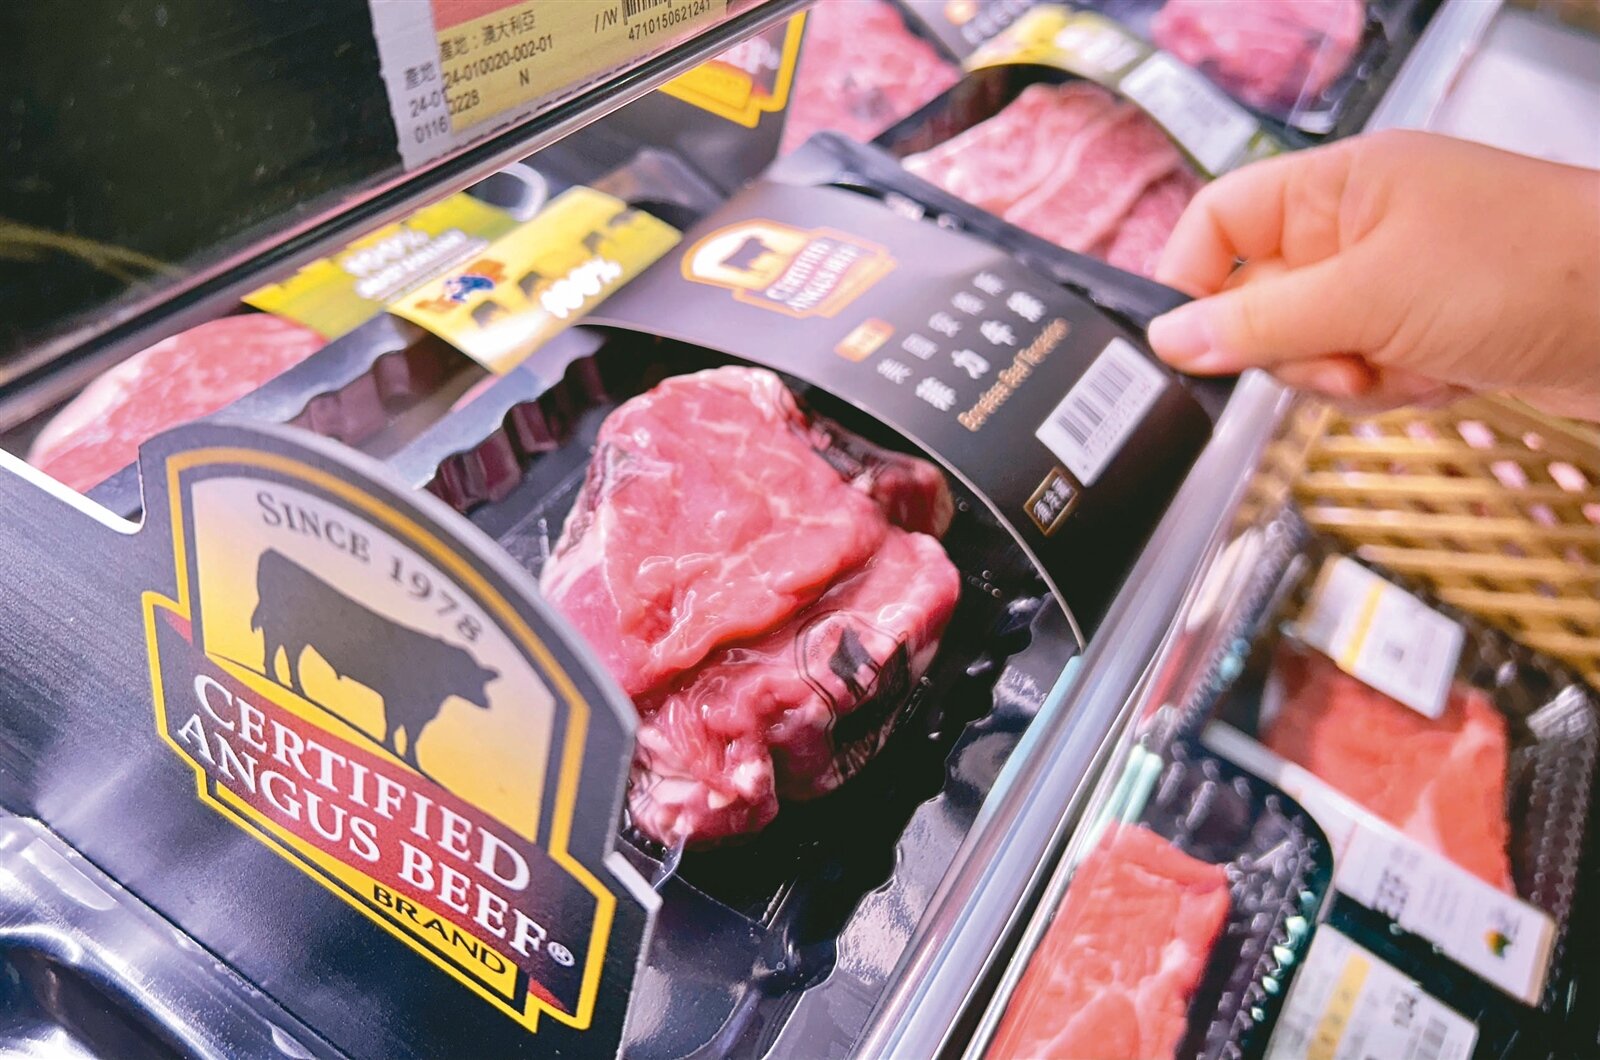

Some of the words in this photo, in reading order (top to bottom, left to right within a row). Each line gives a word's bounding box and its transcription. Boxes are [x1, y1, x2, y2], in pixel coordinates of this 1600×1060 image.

[628, 0, 711, 41] 4710150621241
[519, 68, 530, 86] N
[414, 116, 449, 143] 0116
[257, 491, 371, 564] SINCE
[388, 556, 483, 643] 1978
[177, 713, 381, 863] ANGUS
[193, 674, 531, 892] CERTIFIED
[373, 884, 506, 975] BRAND
